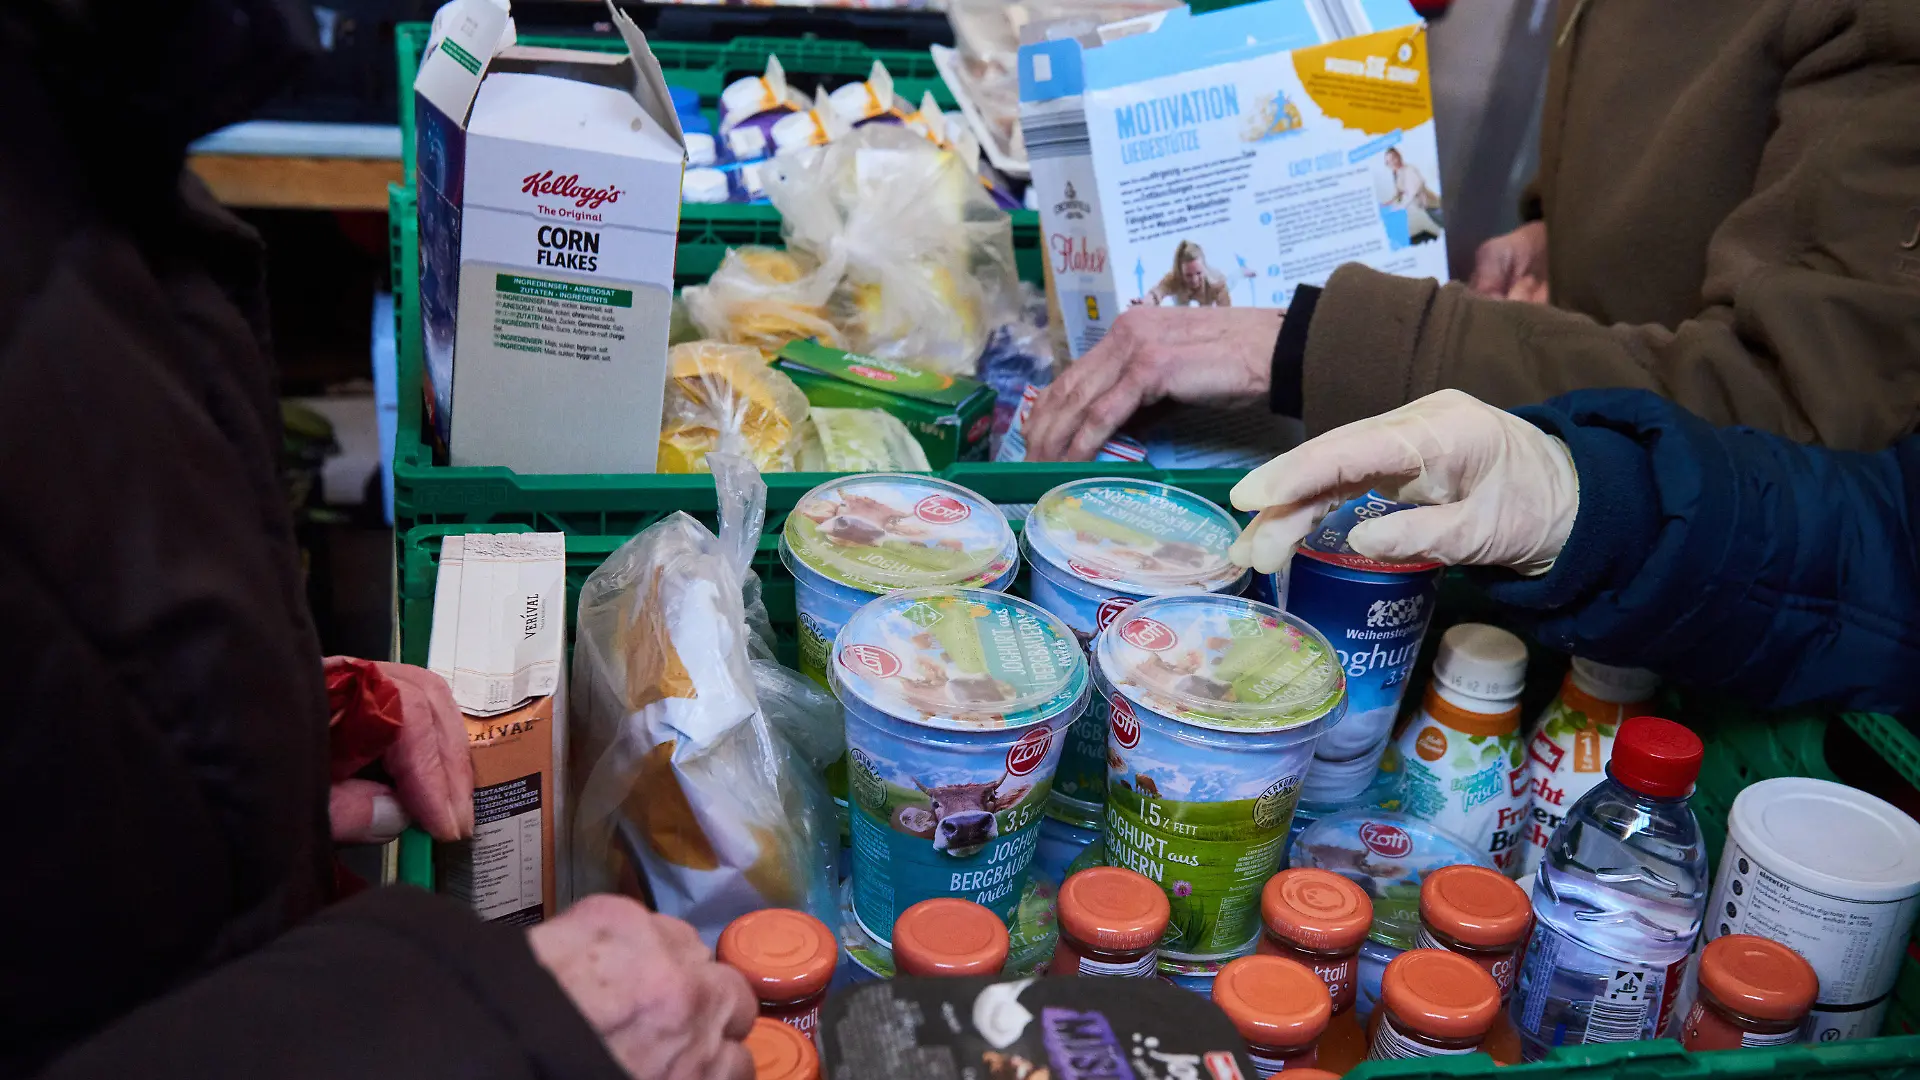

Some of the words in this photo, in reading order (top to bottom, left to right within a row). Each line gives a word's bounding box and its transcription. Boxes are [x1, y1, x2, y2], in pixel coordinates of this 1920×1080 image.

[1114, 83, 1240, 139] MOTIVATION
[522, 170, 621, 209] Kellogg's
[538, 205, 556, 215] The
[558, 208, 602, 221] Original
[538, 225, 600, 254] CORN
[537, 249, 598, 272] FLAKES
[513, 278, 568, 290] INGREDIENSER
[574, 286, 616, 297] AINESOSAT
[520, 287, 554, 297] ZUTATEN
[559, 292, 608, 304] INGREDIENTS
[520, 593, 539, 640] VERÍVAL
[1130, 618, 1166, 647] Zott
[1336, 641, 1421, 677] oghur
[1013, 736, 1047, 765] Zott
[1531, 777, 1565, 806] cht
[1005, 803, 1032, 832] 3,5
[1139, 798, 1162, 827] 1,5
[1173, 821, 1198, 836] FETT
[1366, 827, 1407, 849] Zott
[1167, 851, 1200, 867] aus
[975, 880, 1014, 905] Milch
[1314, 962, 1348, 982] ktail
[783, 1007, 818, 1031] ktail
